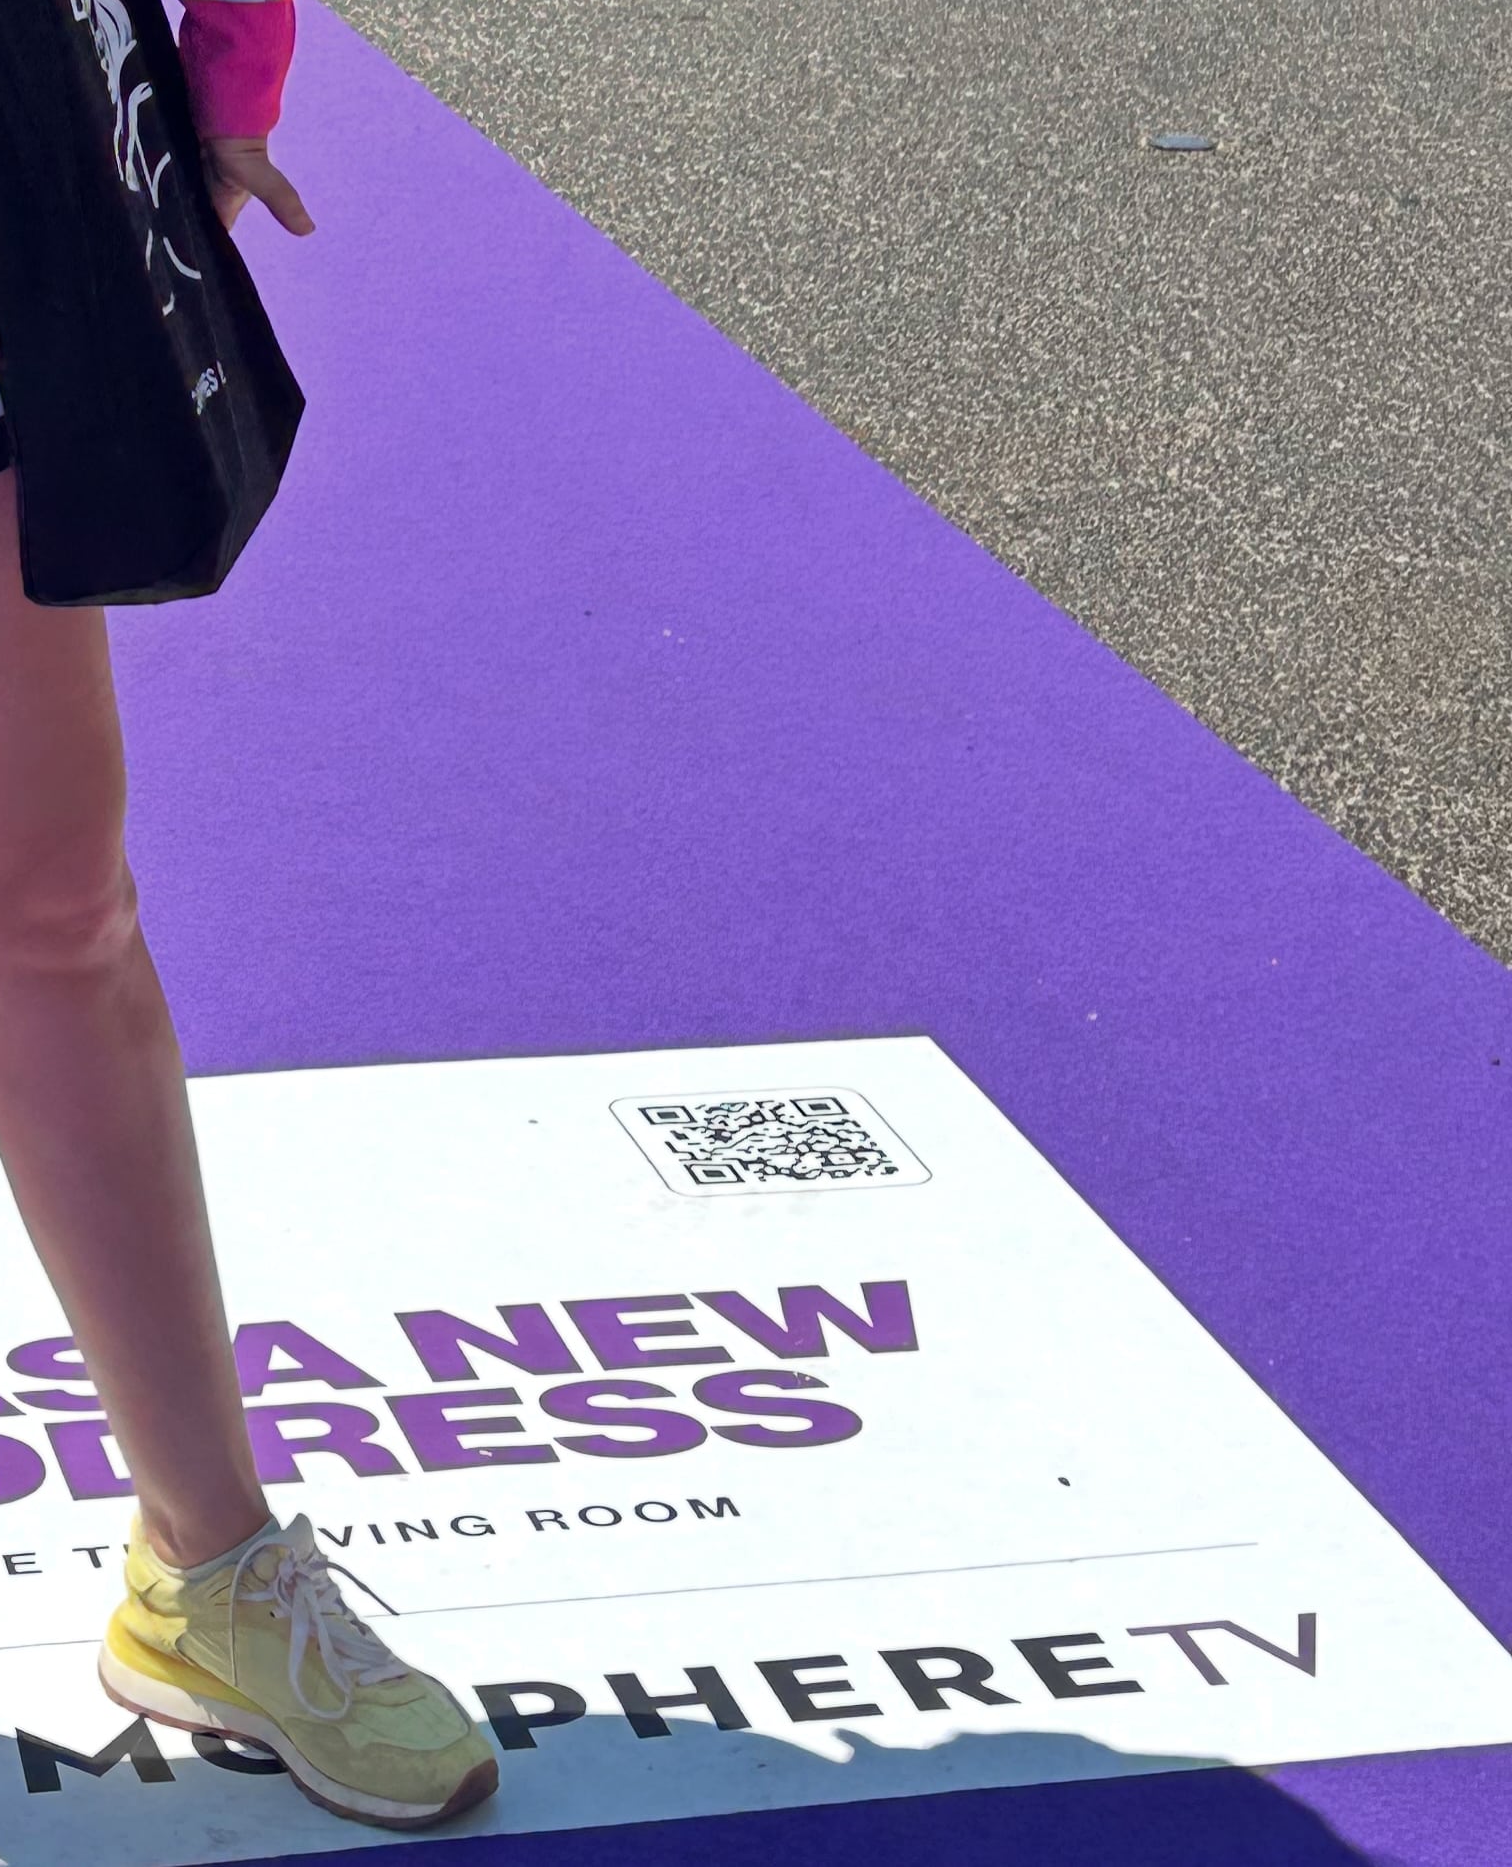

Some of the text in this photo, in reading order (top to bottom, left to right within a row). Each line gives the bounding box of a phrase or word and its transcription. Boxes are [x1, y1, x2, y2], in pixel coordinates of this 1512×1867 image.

[233, 1320, 388, 1398] A
[394, 1280, 919, 1382] NEW
[318, 1514, 496, 1548] VING
[525, 1496, 741, 1532] ROOM
